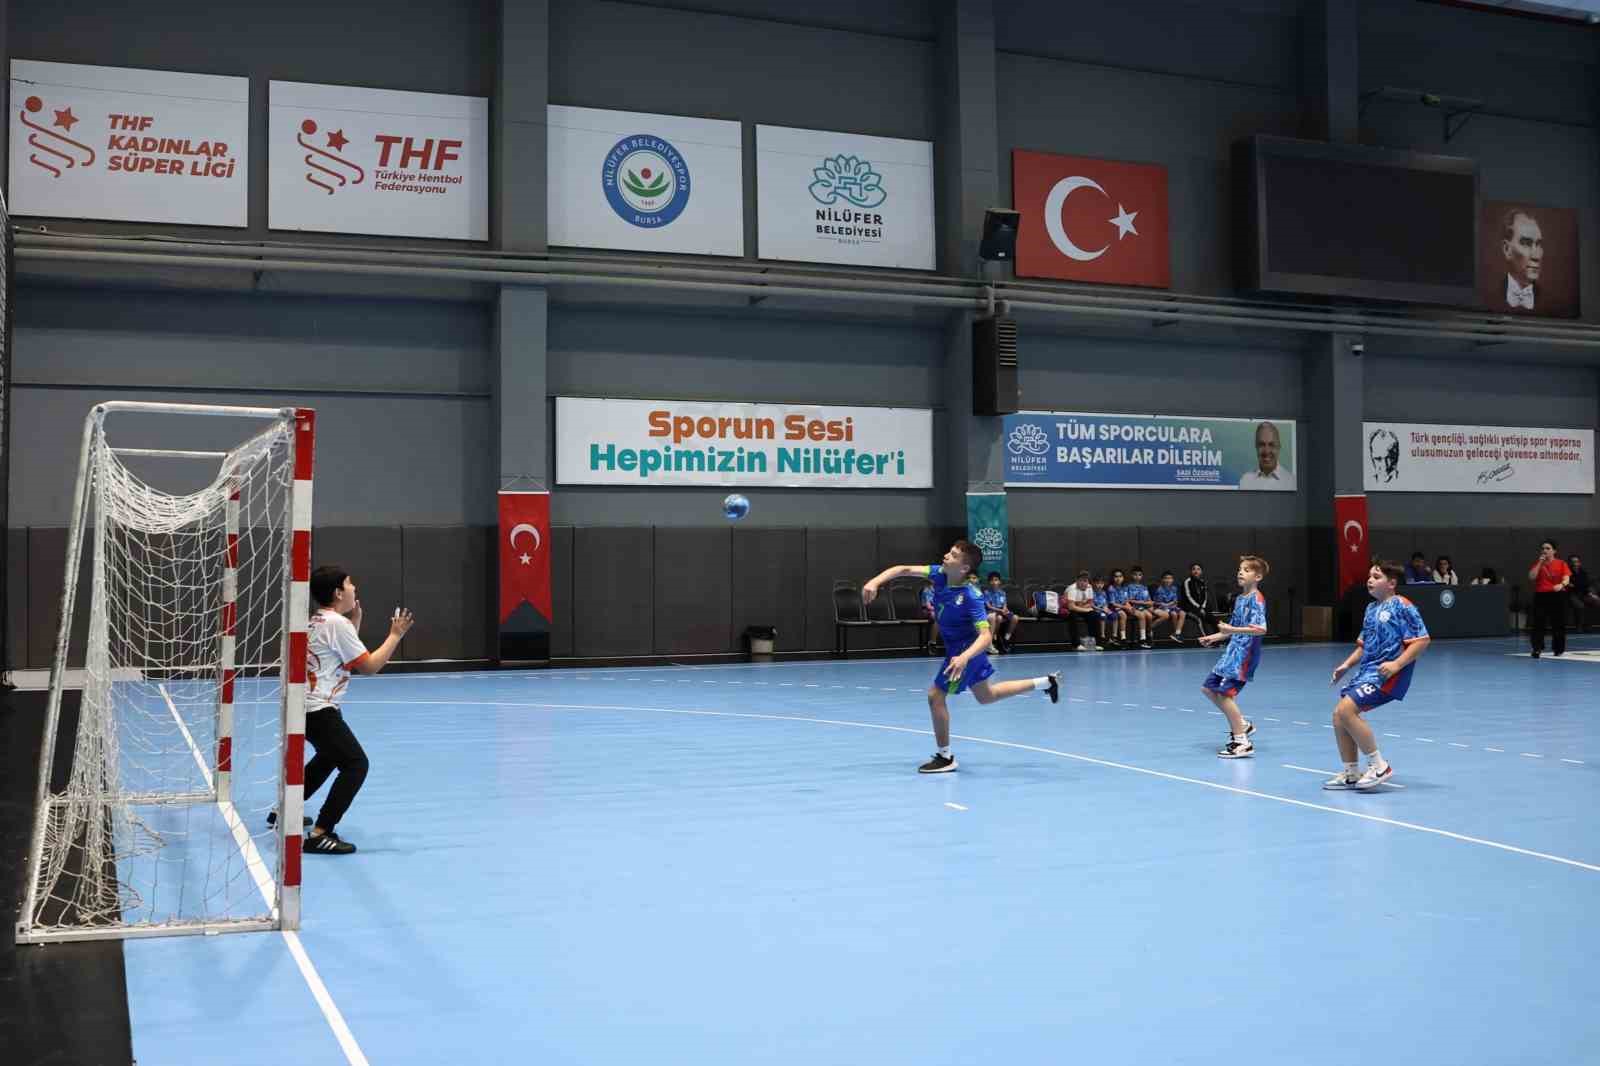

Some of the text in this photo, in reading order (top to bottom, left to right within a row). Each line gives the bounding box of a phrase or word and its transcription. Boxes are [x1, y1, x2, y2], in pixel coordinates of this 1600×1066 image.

[108, 114, 154, 131] THF
[107, 135, 229, 157] KADINLAR
[374, 134, 463, 171] THF
[107, 152, 185, 175] SÜPER
[374, 170, 463, 185] Türkiye Hentbol
[374, 181, 447, 194] Federasyonu
[816, 208, 883, 225] NİLÜFER
[816, 225, 881, 238] BELEDİYESİ
[648, 411, 853, 443] Sporun Sesi
[1056, 419, 1213, 443] TÜM SPORCULARA
[1411, 432, 1429, 443] Türk
[1530, 437, 1547, 447] spor
[1549, 438, 1581, 449] yaparsa
[590, 443, 905, 477] Hepimizin Nilüfer'i
[1056, 446, 1222, 469] BAŞARILAR DİLERİM
[1411, 447, 1464, 458] ulusumuzun
[1503, 449, 1538, 461] güvence
